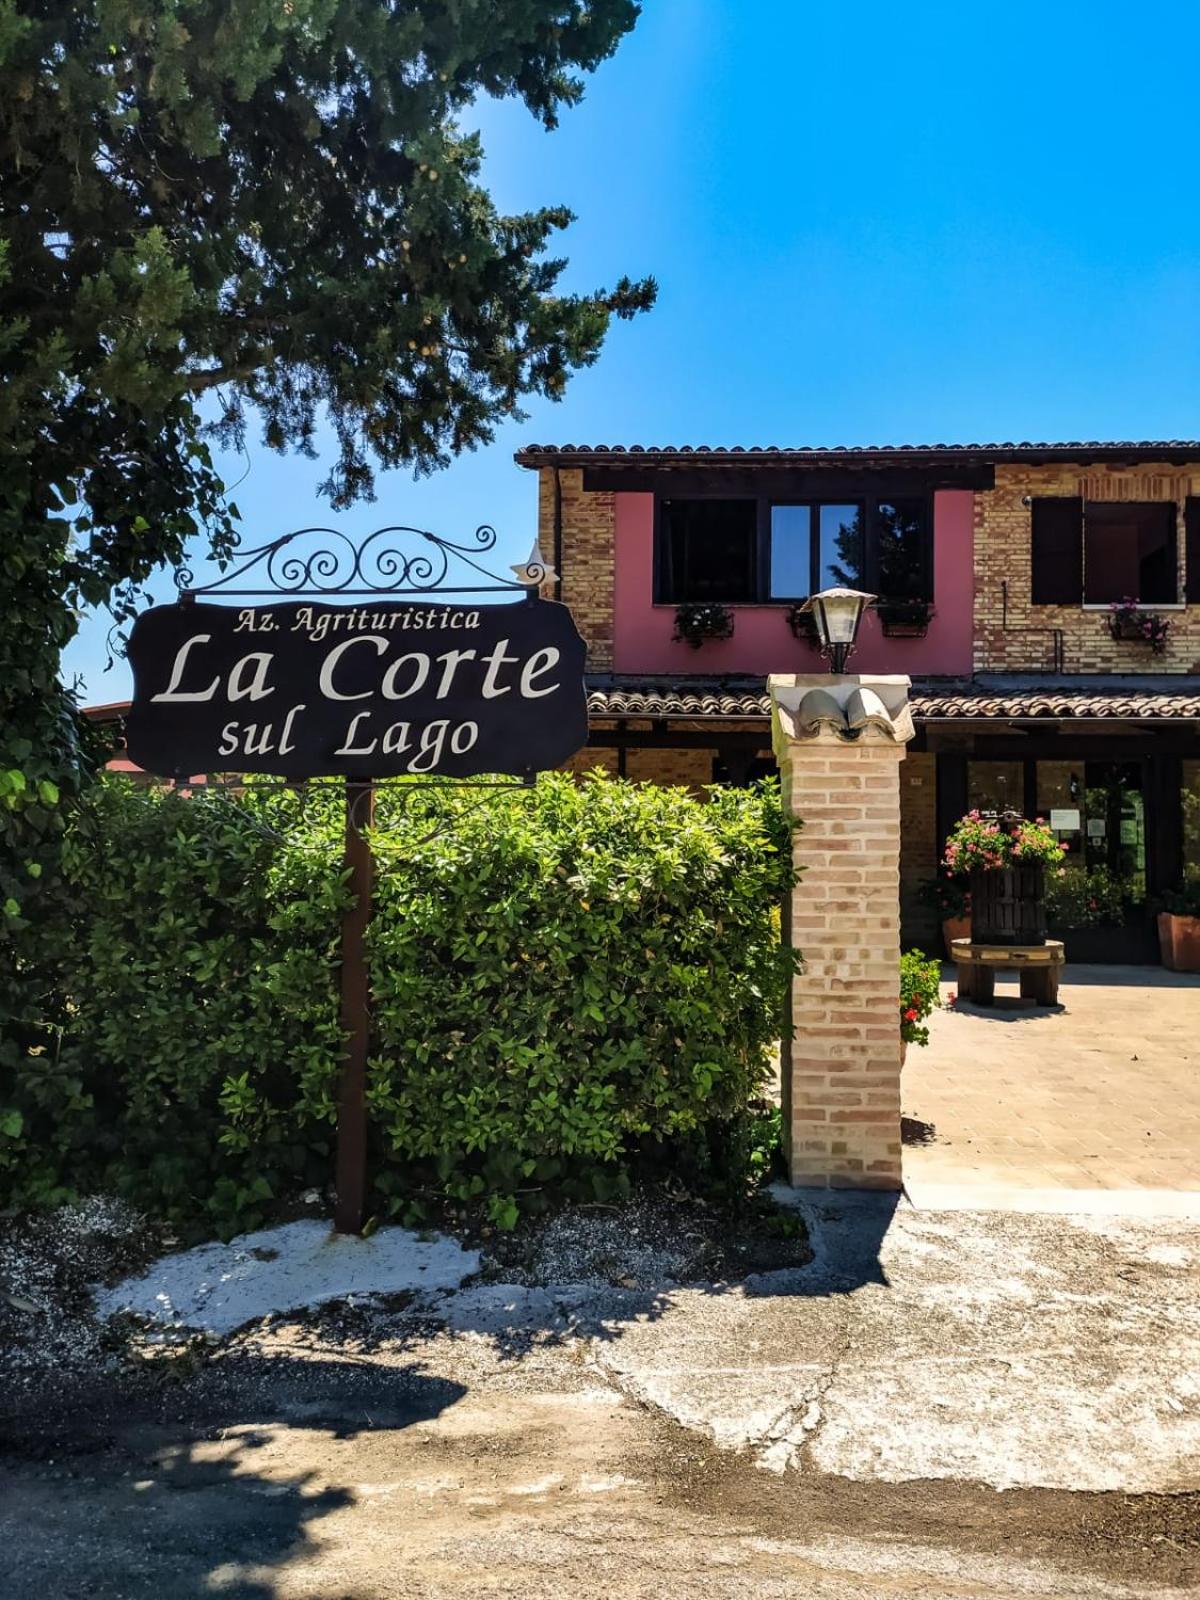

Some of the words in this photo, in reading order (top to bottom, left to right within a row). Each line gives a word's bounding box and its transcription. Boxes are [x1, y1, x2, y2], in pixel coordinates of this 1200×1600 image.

[233, 608, 280, 632] Az.
[291, 606, 480, 642] Agrituristica
[150, 634, 275, 702] La
[319, 635, 561, 701] Corte
[218, 704, 306, 756] sul
[334, 711, 479, 773] Lago
